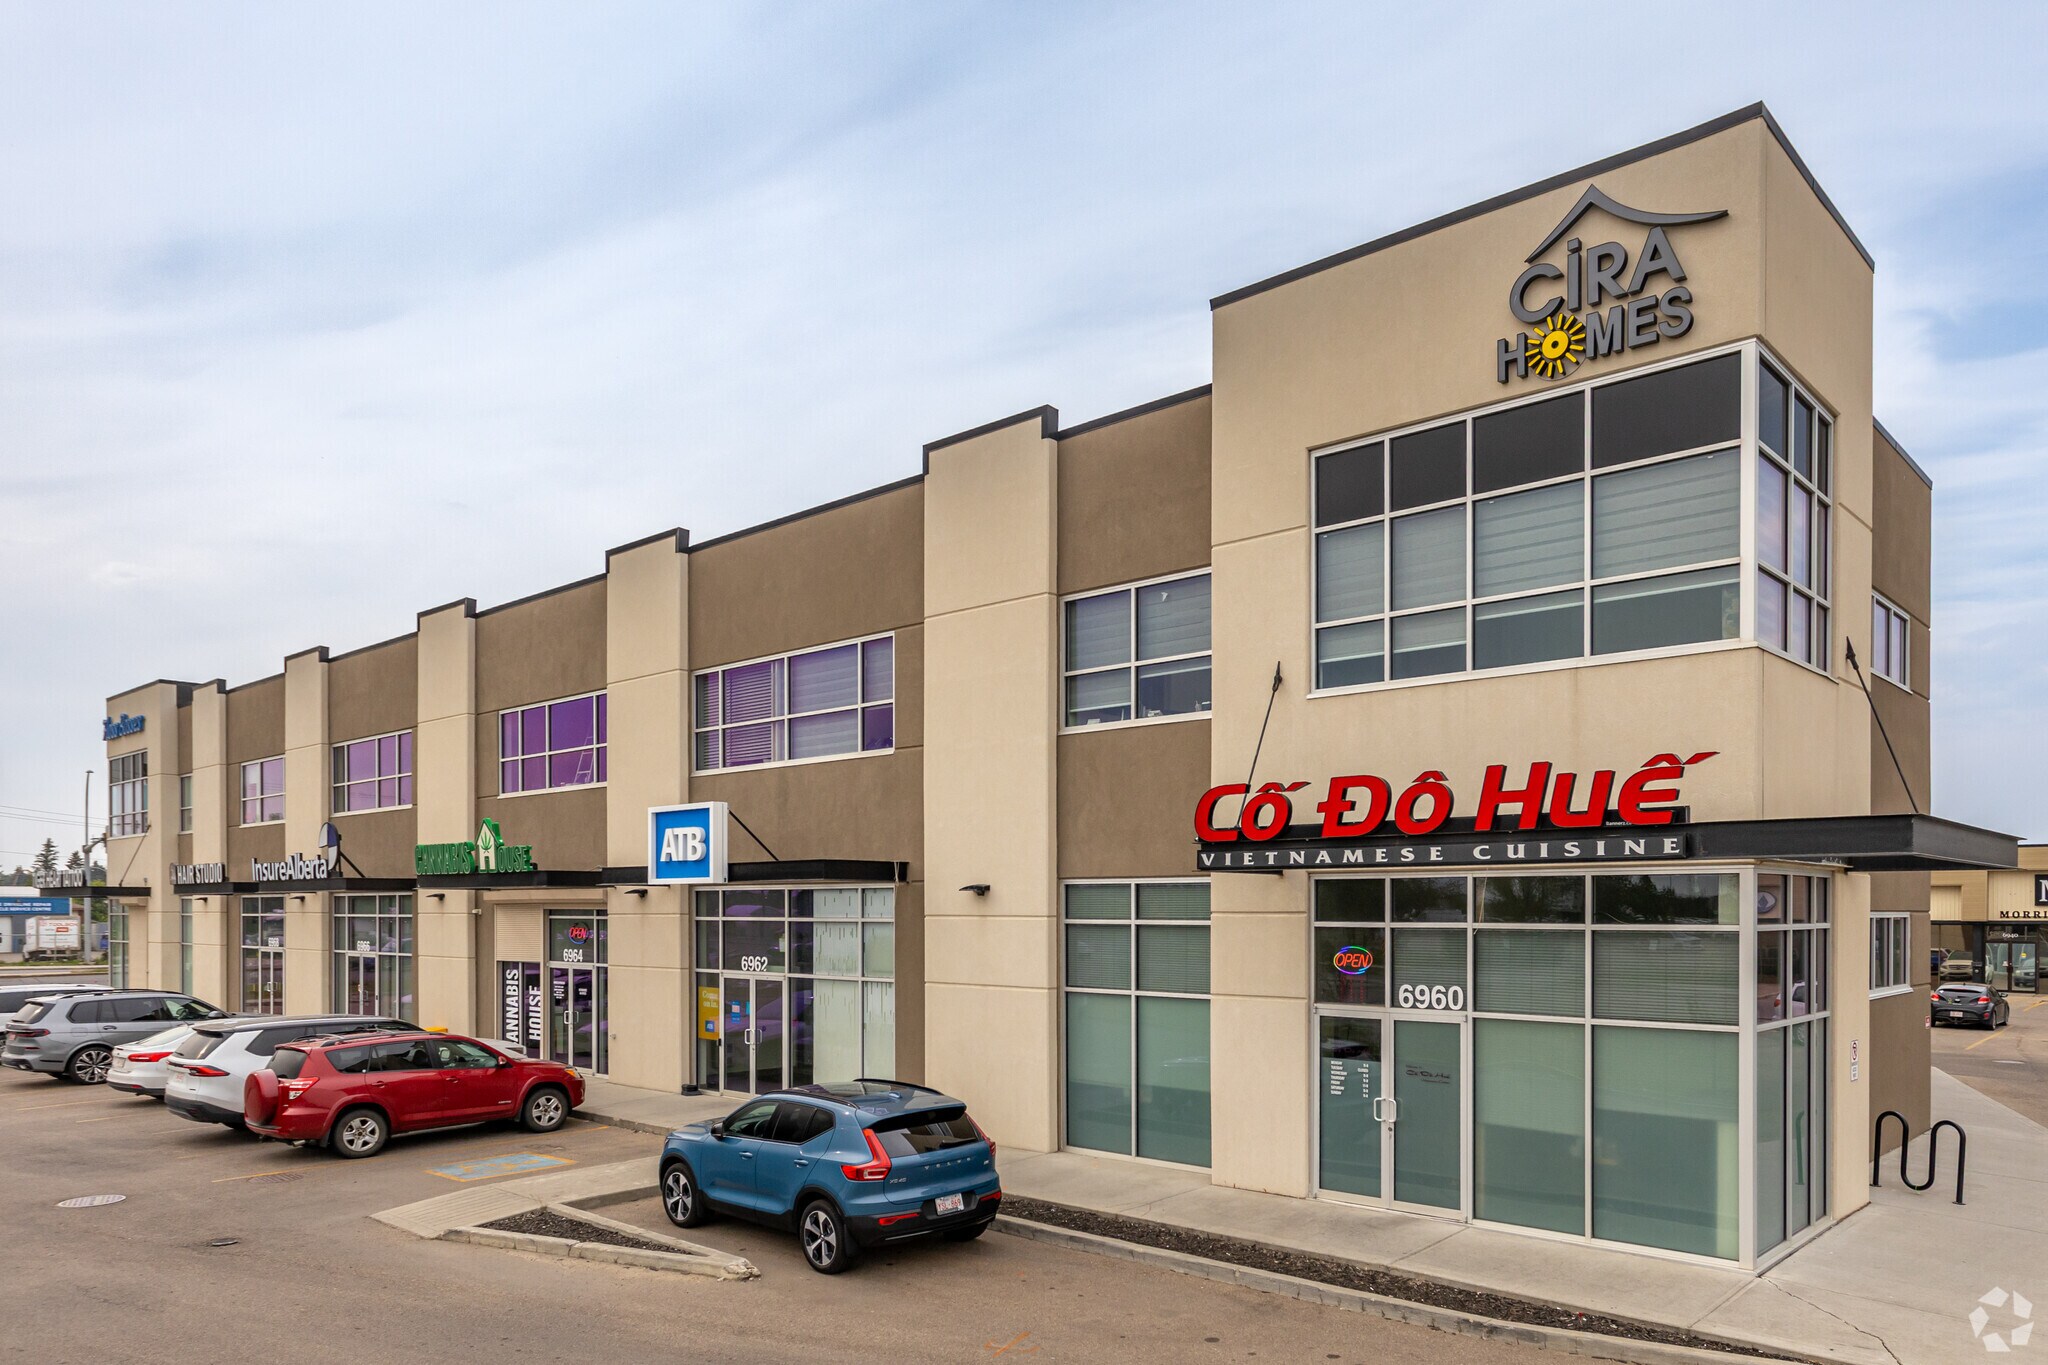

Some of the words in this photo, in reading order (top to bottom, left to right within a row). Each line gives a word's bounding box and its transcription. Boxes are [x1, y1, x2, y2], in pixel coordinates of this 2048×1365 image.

[1497, 286, 1694, 384] HOMES
[415, 842, 473, 875] CANNABIS
[478, 818, 533, 873] HOUSE
[660, 827, 706, 861] ATB
[1201, 847, 1443, 866] VIETNAMESE
[1473, 838, 1680, 860] CUISINE
[177, 865, 194, 884] HAIR
[195, 863, 222, 884] STUDIO
[252, 853, 327, 881] InsureAlberta
[569, 927, 587, 939] OPEN
[563, 949, 583, 962] 6964
[741, 956, 768, 971] 6962
[1335, 953, 1369, 968] OPEN
[1399, 984, 1464, 1010] 6960
